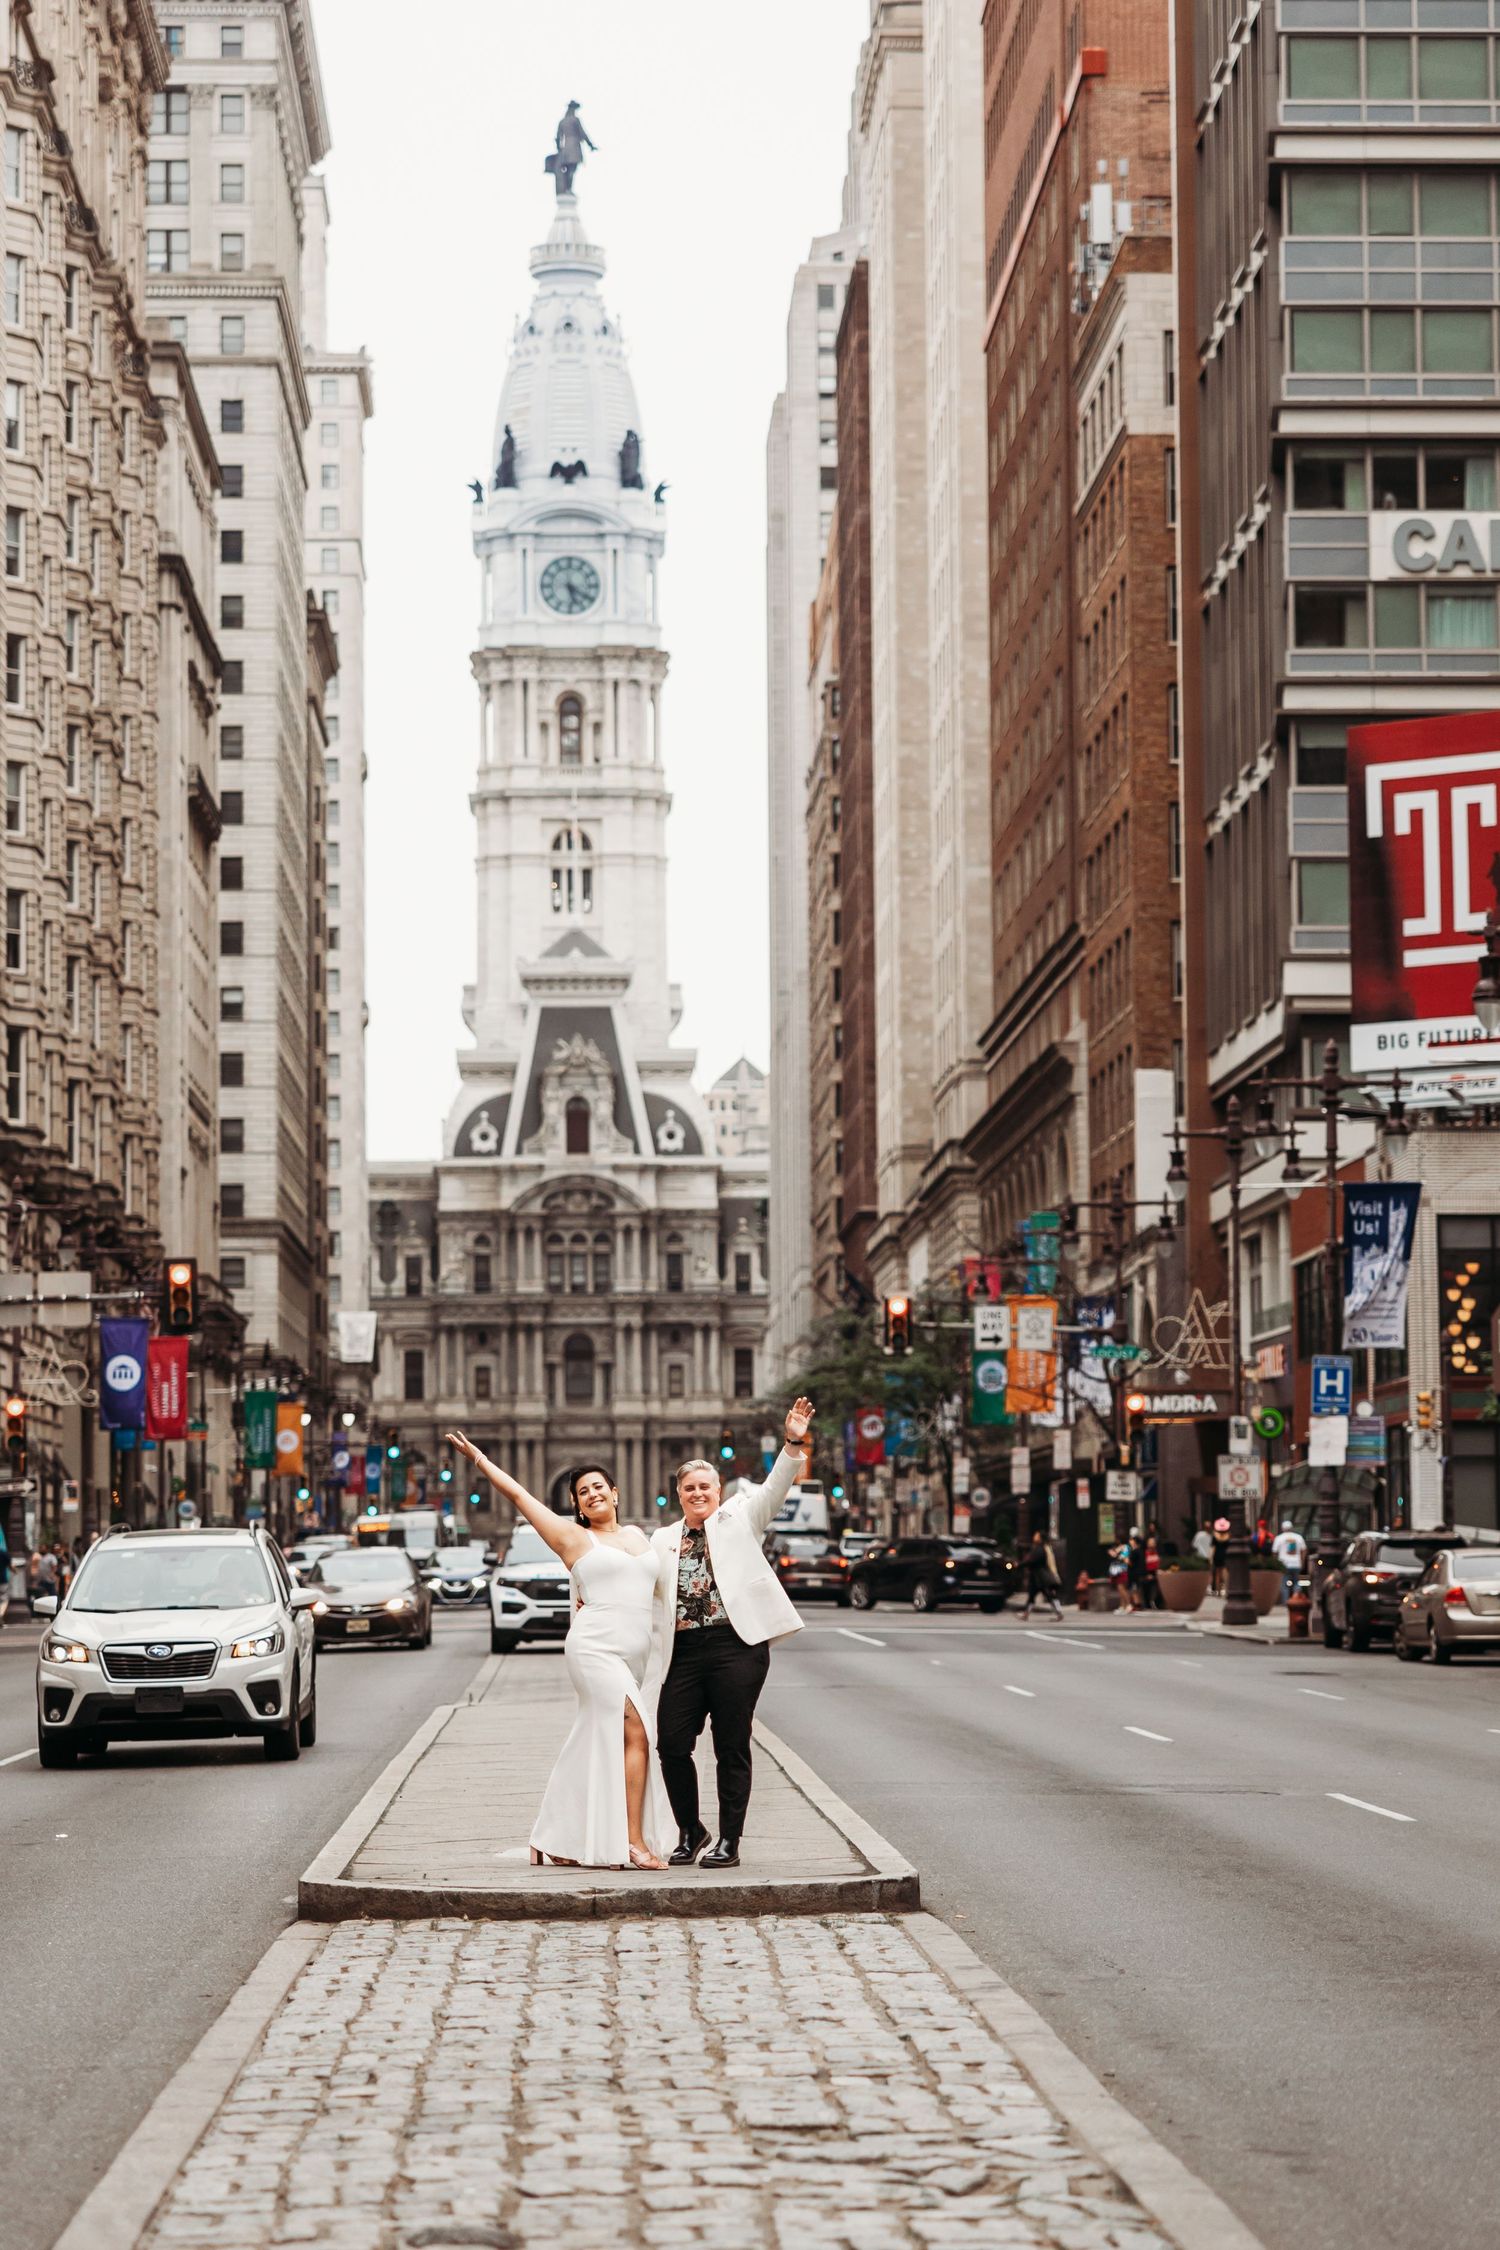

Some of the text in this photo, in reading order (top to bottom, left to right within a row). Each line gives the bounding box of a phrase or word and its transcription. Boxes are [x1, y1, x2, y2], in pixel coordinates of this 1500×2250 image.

[1393, 519, 1500, 573] CA
[1377, 1034, 1409, 1050] BIG
[1349, 1200, 1383, 1216] Visit
[1354, 1220, 1380, 1236] Us!
[982, 1311, 1002, 1319] ONE
[982, 1323, 1003, 1331] WAY
[1320, 1370, 1344, 1394] H
